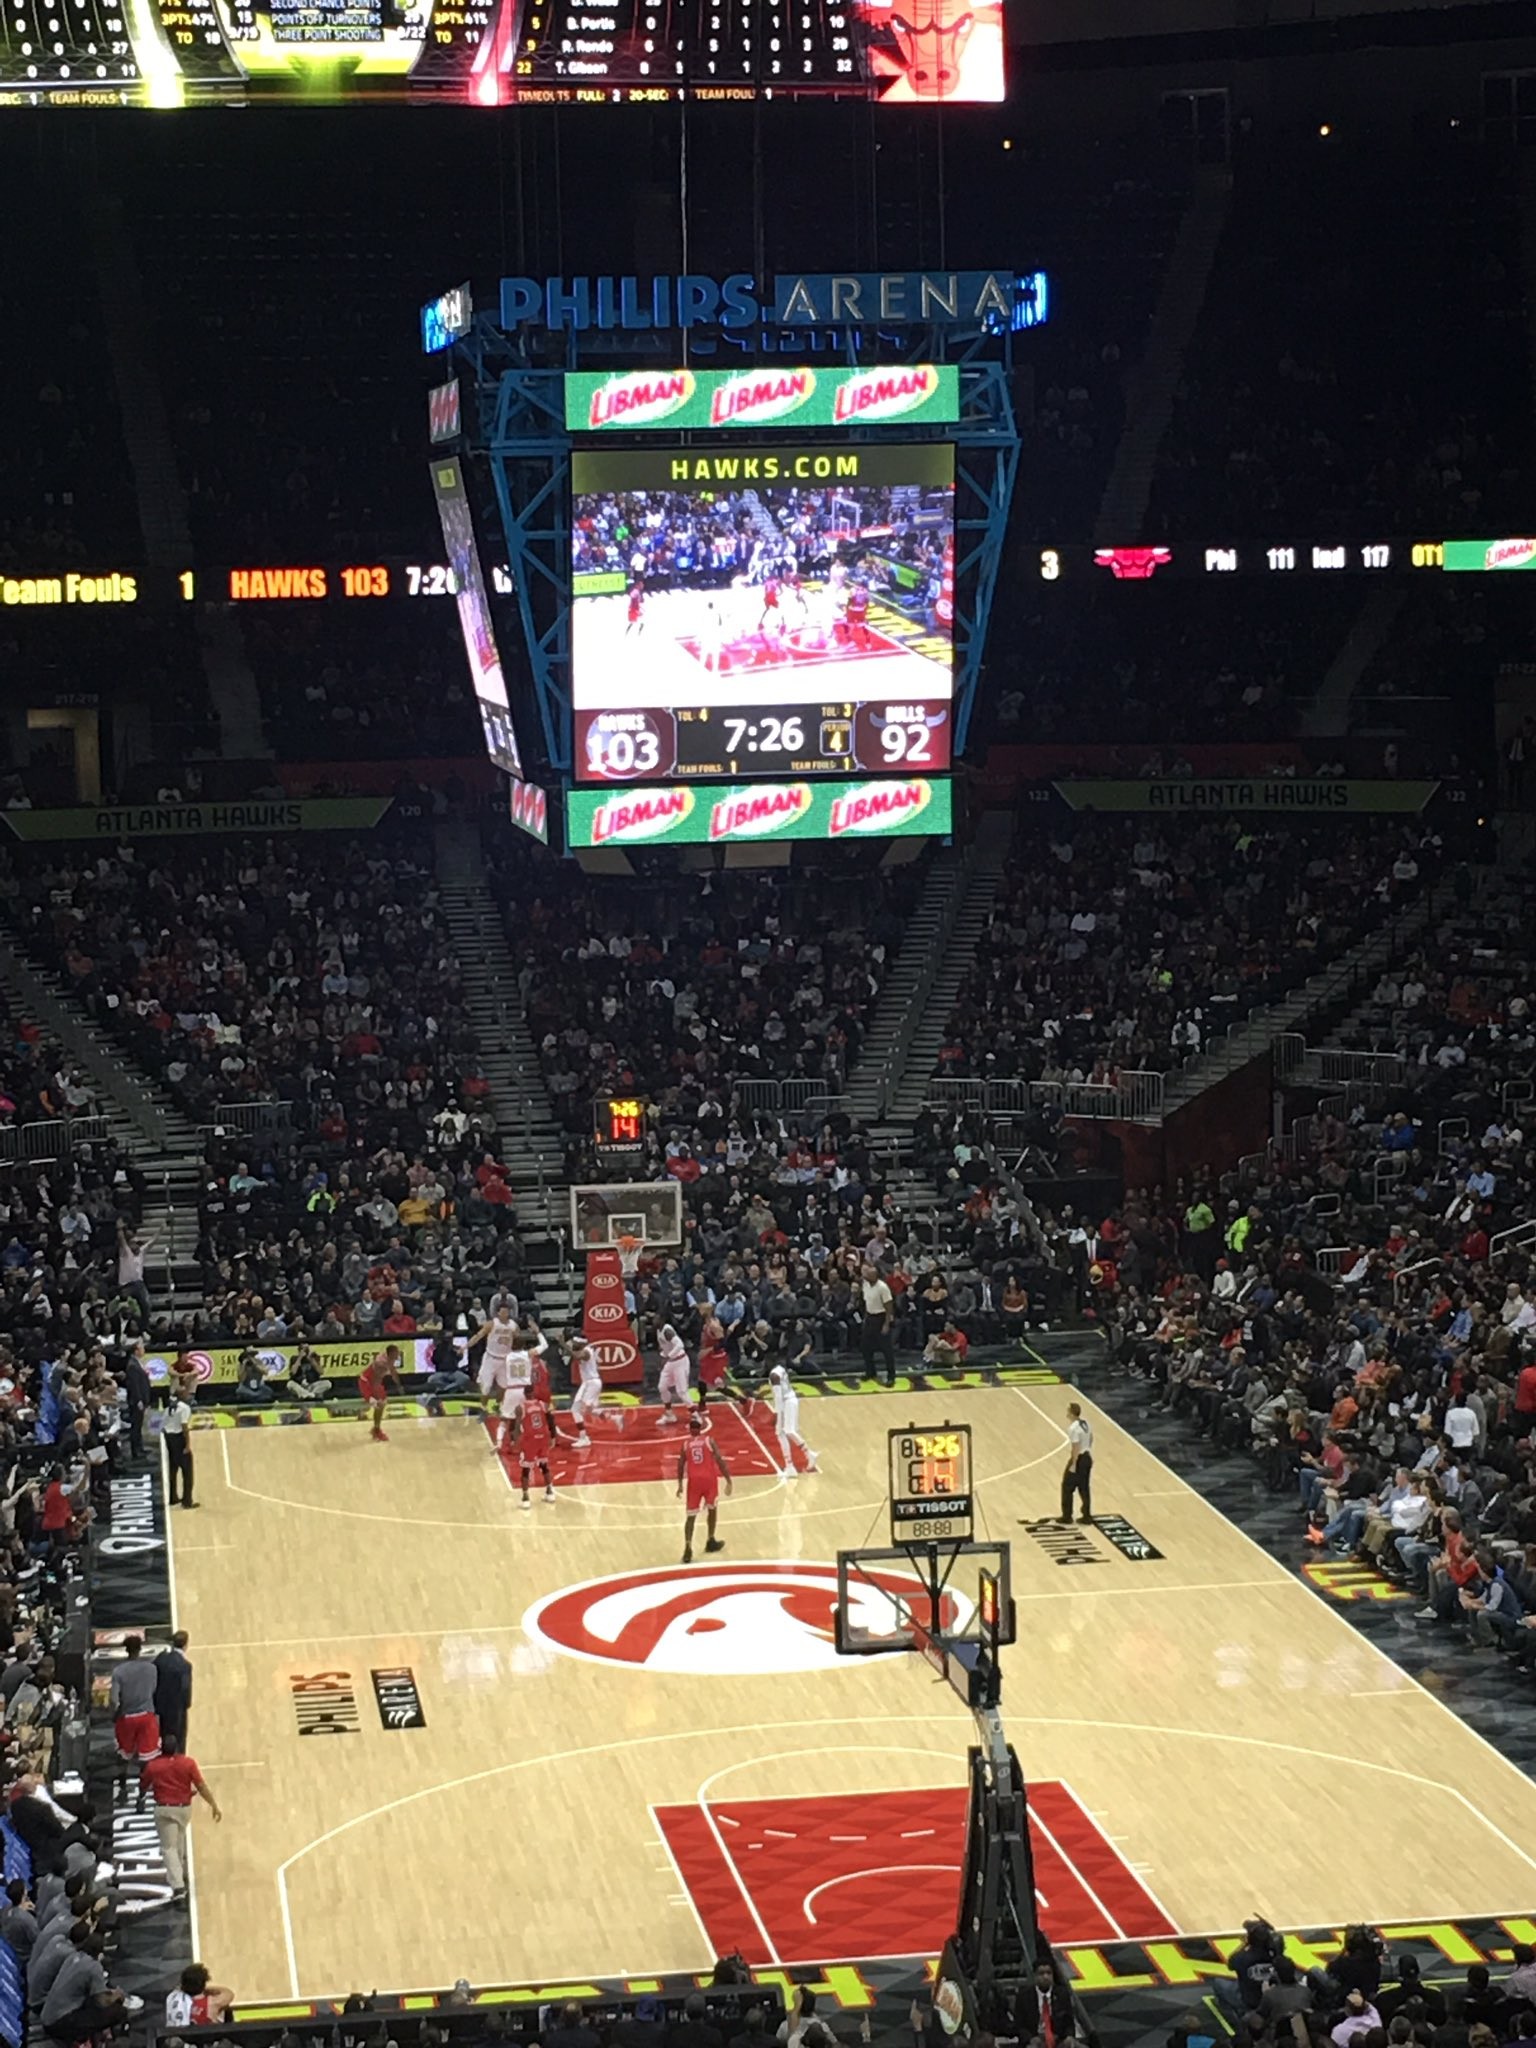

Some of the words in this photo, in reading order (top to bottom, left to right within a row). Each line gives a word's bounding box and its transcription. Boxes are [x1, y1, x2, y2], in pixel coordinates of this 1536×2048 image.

[83, 19, 91, 32] 1
[271, 13, 305, 25] POINTS
[306, 13, 324, 25] OFF
[326, 12, 382, 25] TURNOVERS
[741, 15, 749, 29] 1
[772, 15, 780, 29] 1
[176, 31, 193, 44] TO
[274, 28, 303, 40] THREE
[305, 28, 332, 40] POINT
[334, 28, 382, 41] SHOOTING
[435, 31, 452, 44] TO
[465, 31, 480, 44] 11
[112, 41, 128, 55] 27
[743, 38, 750, 52] 1
[121, 64, 136, 77] 11
[516, 61, 532, 74] 22
[568, 61, 608, 75] Gibson
[708, 61, 715, 74] 1
[742, 60, 750, 74] 1
[29, 92, 38, 106] 1
[49, 92, 79, 104] TEAM
[119, 92, 128, 105] 1
[576, 89, 606, 102] FULL:
[612, 89, 622, 102] 2
[677, 88, 685, 101] 1
[695, 89, 725, 100] TEAM
[765, 87, 773, 100] 1
[500, 274, 759, 331] PHILIPS
[782, 273, 1011, 322] ARENA
[591, 376, 685, 426] LIBMAN
[712, 373, 806, 424] LIBMAN
[835, 370, 929, 421] LIBMAN
[671, 455, 859, 481] HAWKS.COM
[1041, 551, 1059, 580] 3
[1266, 547, 1295, 570] 111
[1312, 546, 1345, 569] Ind
[1361, 545, 1389, 568] 117
[0, 576, 62, 604] eam
[66, 573, 137, 603] Fouls
[179, 571, 194, 600] 1
[231, 569, 327, 599] HAWKS
[341, 567, 389, 596] 103
[699, 708, 708, 722] 4
[843, 703, 852, 717] 3
[723, 716, 804, 753] 7:26
[829, 730, 842, 753] 4
[586, 731, 660, 772] 103
[880, 724, 932, 763] 92
[677, 764, 698, 774] TEAM
[730, 760, 737, 774] 1
[790, 760, 811, 771] TEAM
[844, 757, 850, 771] 1
[1149, 784, 1253, 806] ATLANTA
[1264, 784, 1349, 806] HAWKS
[96, 808, 201, 832] ATLANTA
[212, 804, 302, 828] HAWKS
[592, 792, 685, 843] LIBMAN
[711, 788, 802, 839] LIBMAN
[830, 785, 922, 836] LIBMAN
[609, 1101, 639, 1117] 7:26
[613, 1118, 636, 1139] 14
[596, 1276, 614, 1286] KIA
[594, 1309, 618, 1319] KIA
[915, 1434, 960, 1458] 7:26
[692, 1447, 704, 1464] 5
[110, 1473, 155, 1535] FANDUEL
[916, 1500, 967, 1514] TISSOT
[376, 1667, 418, 1712] ARENA
[289, 1671, 361, 1736] PHILIPS
